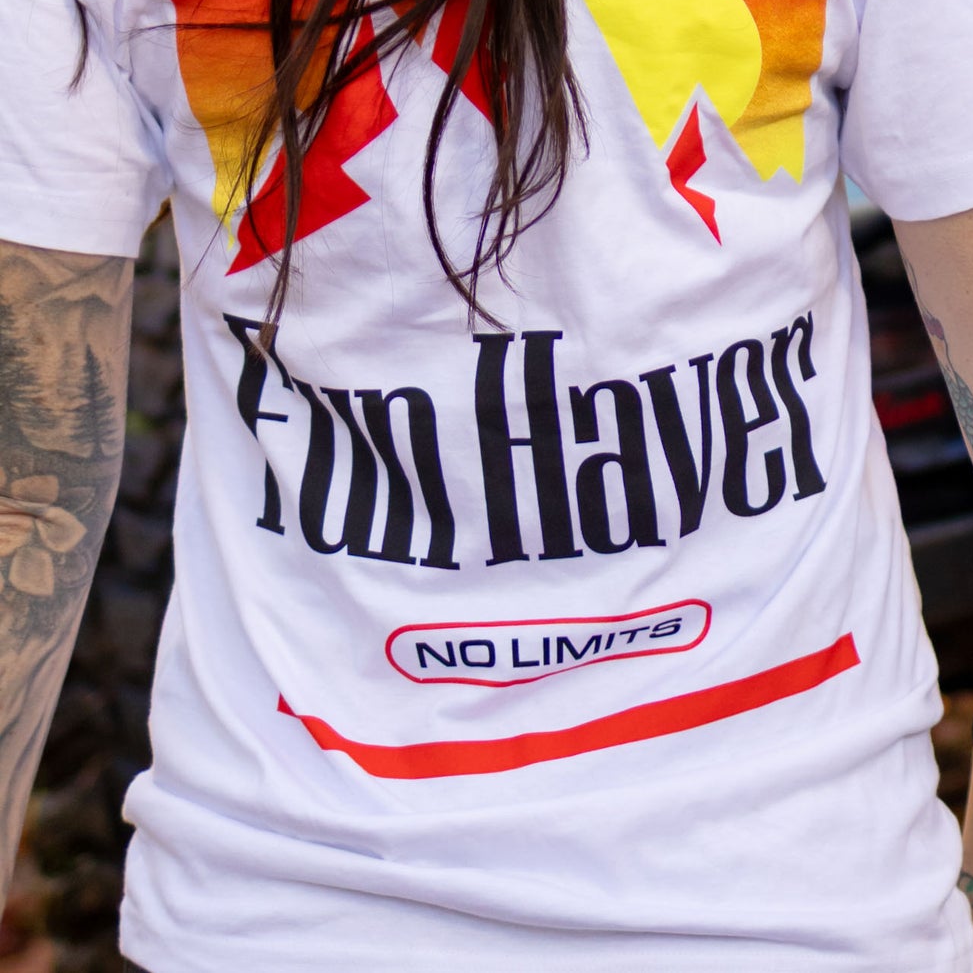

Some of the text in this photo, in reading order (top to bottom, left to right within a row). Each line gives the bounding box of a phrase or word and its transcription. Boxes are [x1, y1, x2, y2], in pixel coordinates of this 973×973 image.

[223, 311, 827, 571] Fun Haver
[415, 617, 682, 668] NO LIMITS
